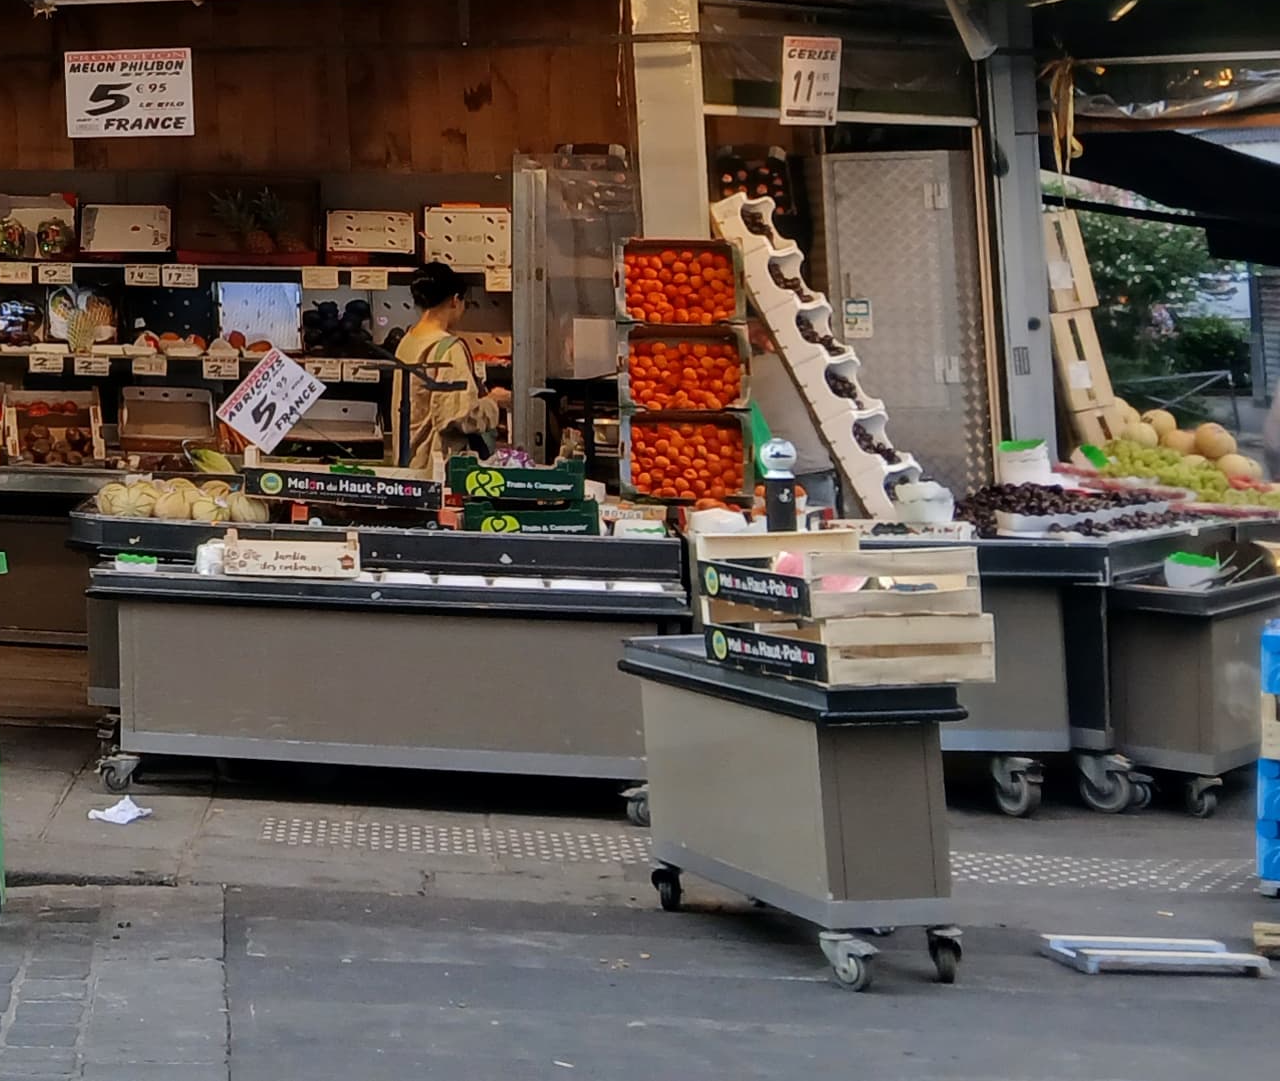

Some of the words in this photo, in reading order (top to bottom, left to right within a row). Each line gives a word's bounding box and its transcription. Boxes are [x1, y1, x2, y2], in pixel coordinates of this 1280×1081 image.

[69, 62, 116, 73] MELON
[120, 60, 184, 72] PHILIBON
[788, 48, 838, 61] CERISE
[148, 83, 167, 93] 95
[793, 70, 815, 103] 11
[84, 82, 132, 117] 5
[104, 116, 186, 132] FRANCE
[228, 359, 283, 422] ABRICOTS
[251, 393, 276, 432] 5
[275, 381, 317, 431] FRANCE
[287, 477, 324, 491] Melon
[339, 479, 422, 497] Haut-Poitou
[758, 641, 815, 665] Haut-Poitou
